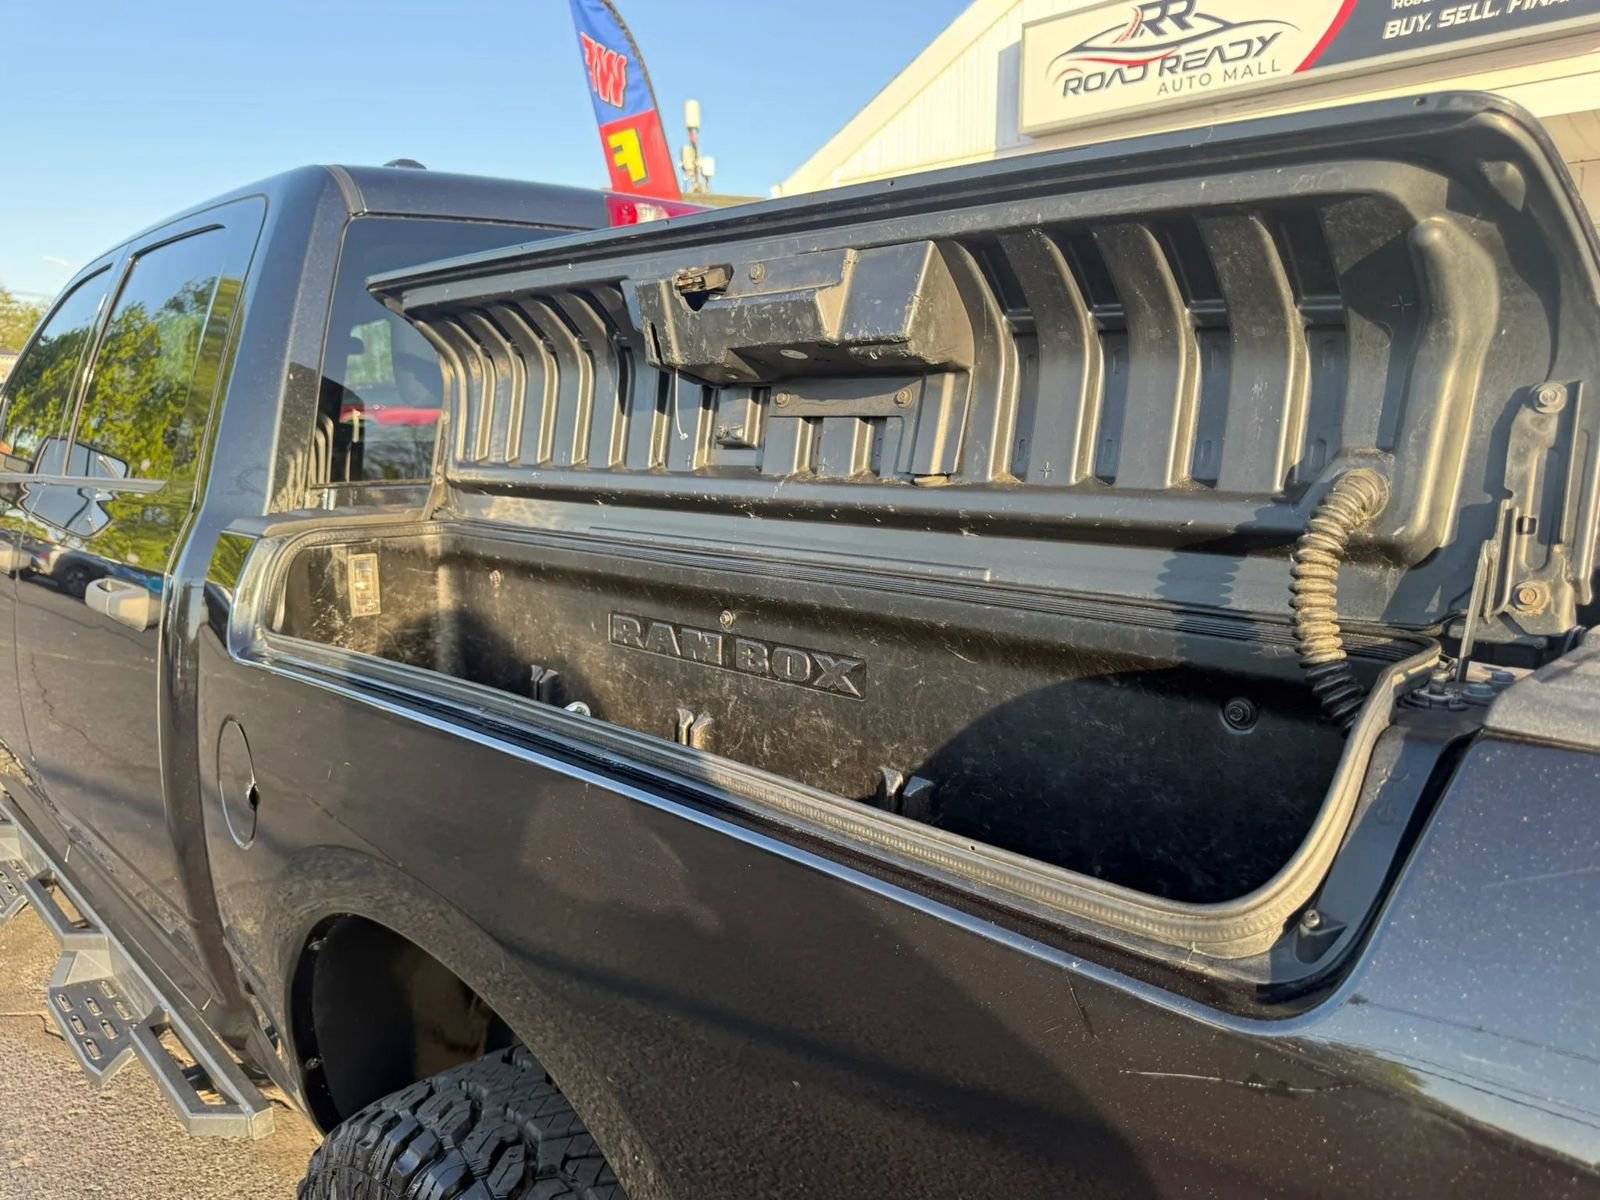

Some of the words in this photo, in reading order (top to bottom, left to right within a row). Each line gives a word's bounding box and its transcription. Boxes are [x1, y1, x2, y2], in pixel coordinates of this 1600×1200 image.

[1131, 0, 1195, 38] RR
[1382, 12, 1432, 40] BUY.
[1062, 62, 1149, 97] ROAD
[1158, 31, 1284, 77] READY
[1157, 72, 1212, 96] AUTO
[1223, 58, 1282, 83] MALL
[610, 613, 723, 666] RAM
[735, 638, 866, 698] BOX
